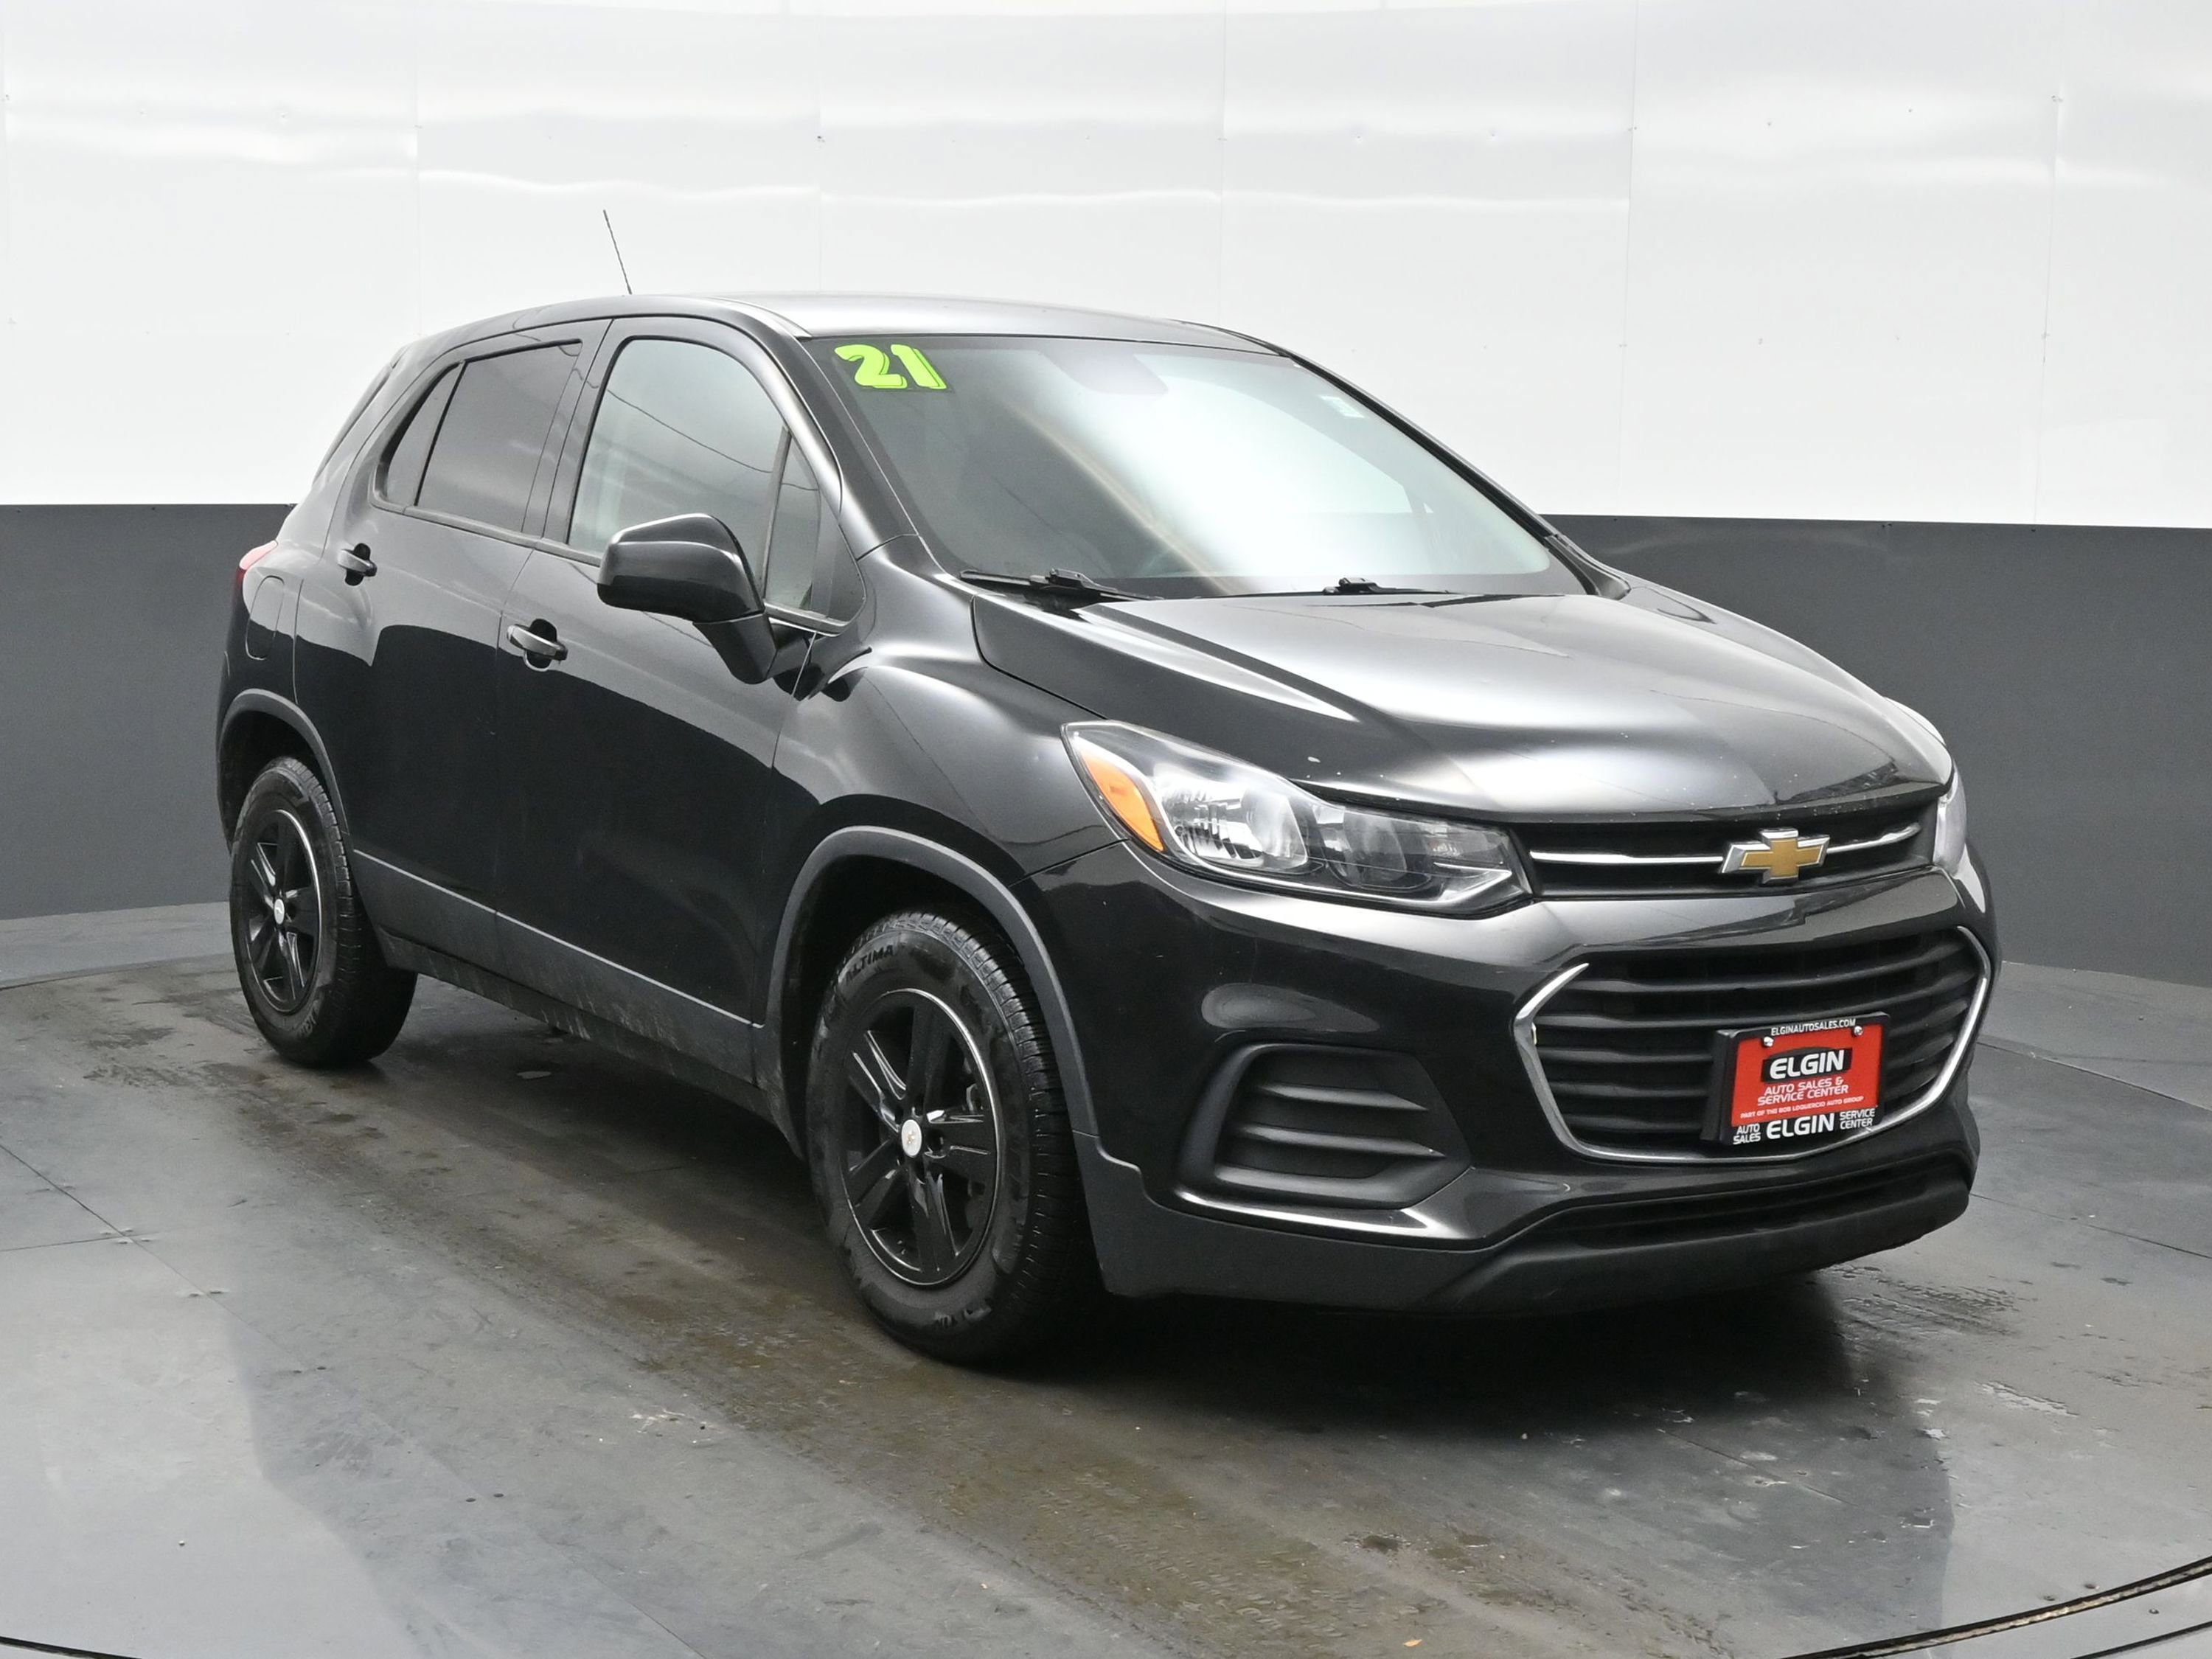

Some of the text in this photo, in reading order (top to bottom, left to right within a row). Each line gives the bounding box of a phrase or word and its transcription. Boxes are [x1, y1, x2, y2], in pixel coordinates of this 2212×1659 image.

[835, 344, 947, 389] 21
[1770, 1018, 1856, 1036] ELGINAUTOSALES.COM
[1770, 1050, 1844, 1079] ELGIN
[1758, 1085, 1848, 1106] SERVICE CENTER
[1764, 1077, 1844, 1096] AUTO SALES &
[1843, 1096, 1864, 1105] GROUP
[1840, 1108, 1875, 1121] SERVICE
[1736, 1123, 1760, 1135] AUTO
[1766, 1113, 1834, 1139] ELGIN
[1840, 1118, 1873, 1130] CENTER
[1733, 1133, 1761, 1144] SALES
